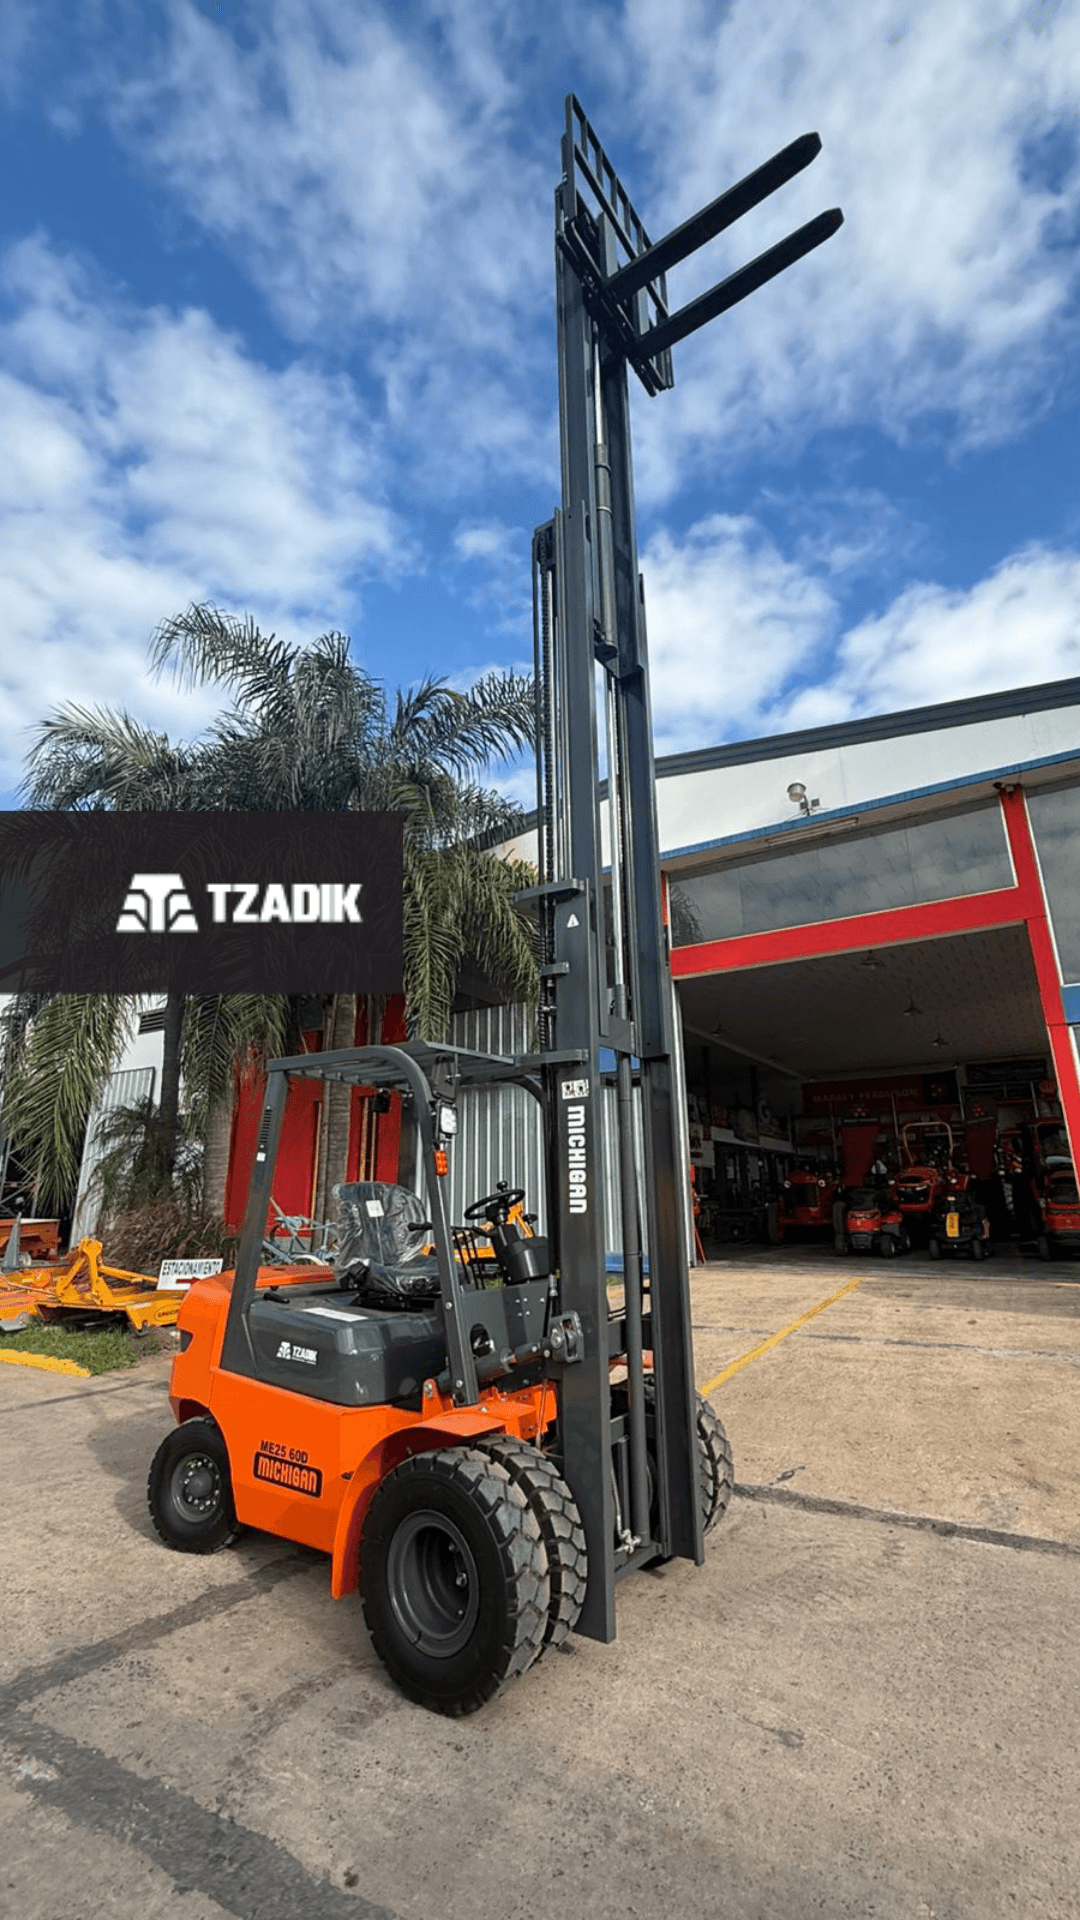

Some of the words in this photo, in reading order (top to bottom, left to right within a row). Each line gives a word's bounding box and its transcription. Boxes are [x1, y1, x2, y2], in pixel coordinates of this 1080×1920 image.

[567, 1104, 588, 1214] MICHIGAN
[162, 1260, 221, 1277] ESTACIONAMIENTO
[292, 1345, 318, 1361] TZADIK
[260, 1440, 287, 1457] ME25
[289, 1447, 308, 1464] 60D
[257, 1456, 318, 1493] MICHIGAN
